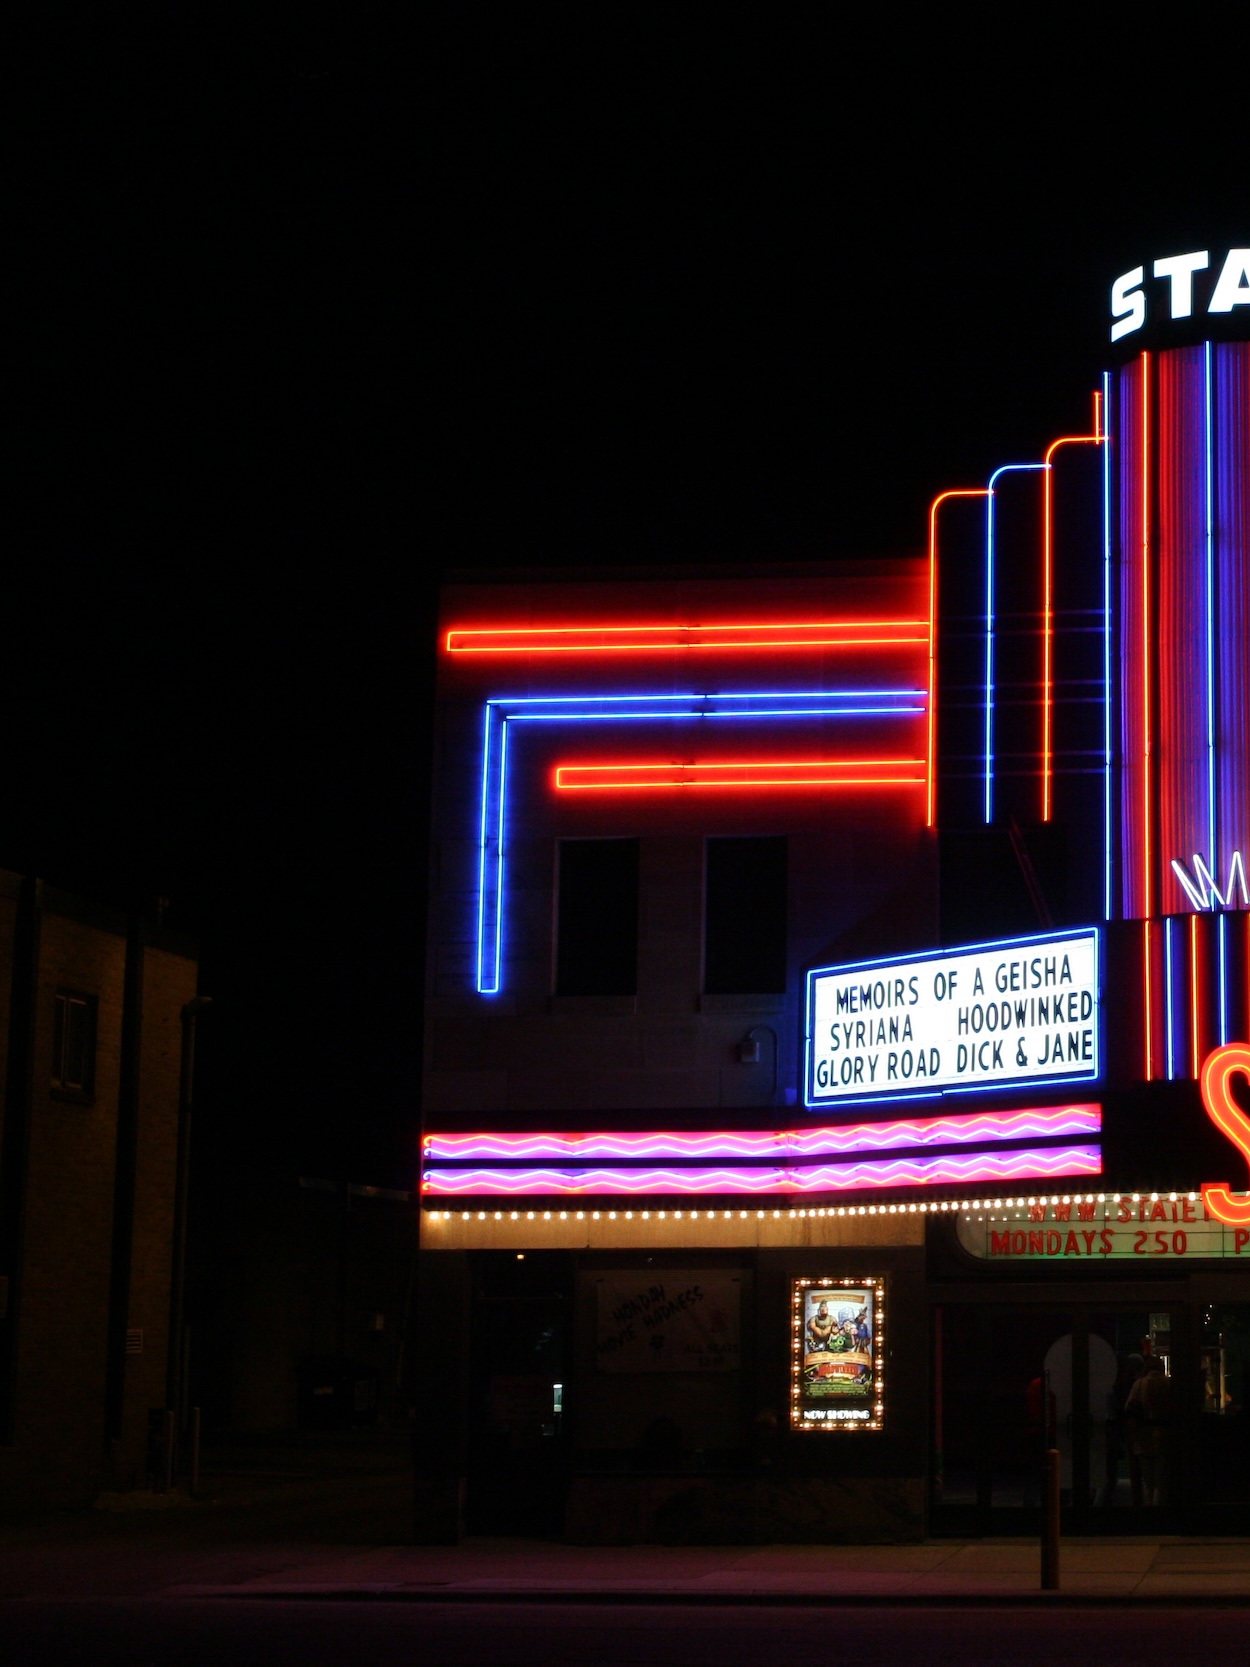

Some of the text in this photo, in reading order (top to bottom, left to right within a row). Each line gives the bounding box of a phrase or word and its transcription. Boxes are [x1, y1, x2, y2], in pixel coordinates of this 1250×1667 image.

[836, 954, 1073, 1016] MEMOIRS OF A GEISHA
[830, 990, 1093, 1052] SYRIANA HOODWINKED
[816, 1029, 1093, 1089] GLORY ROAD DICK & JANE
[990, 1229, 1115, 1256] MONDAYS
[1134, 1230, 1188, 1256] 250
[803, 1409, 870, 1420] NOW SHOWING
